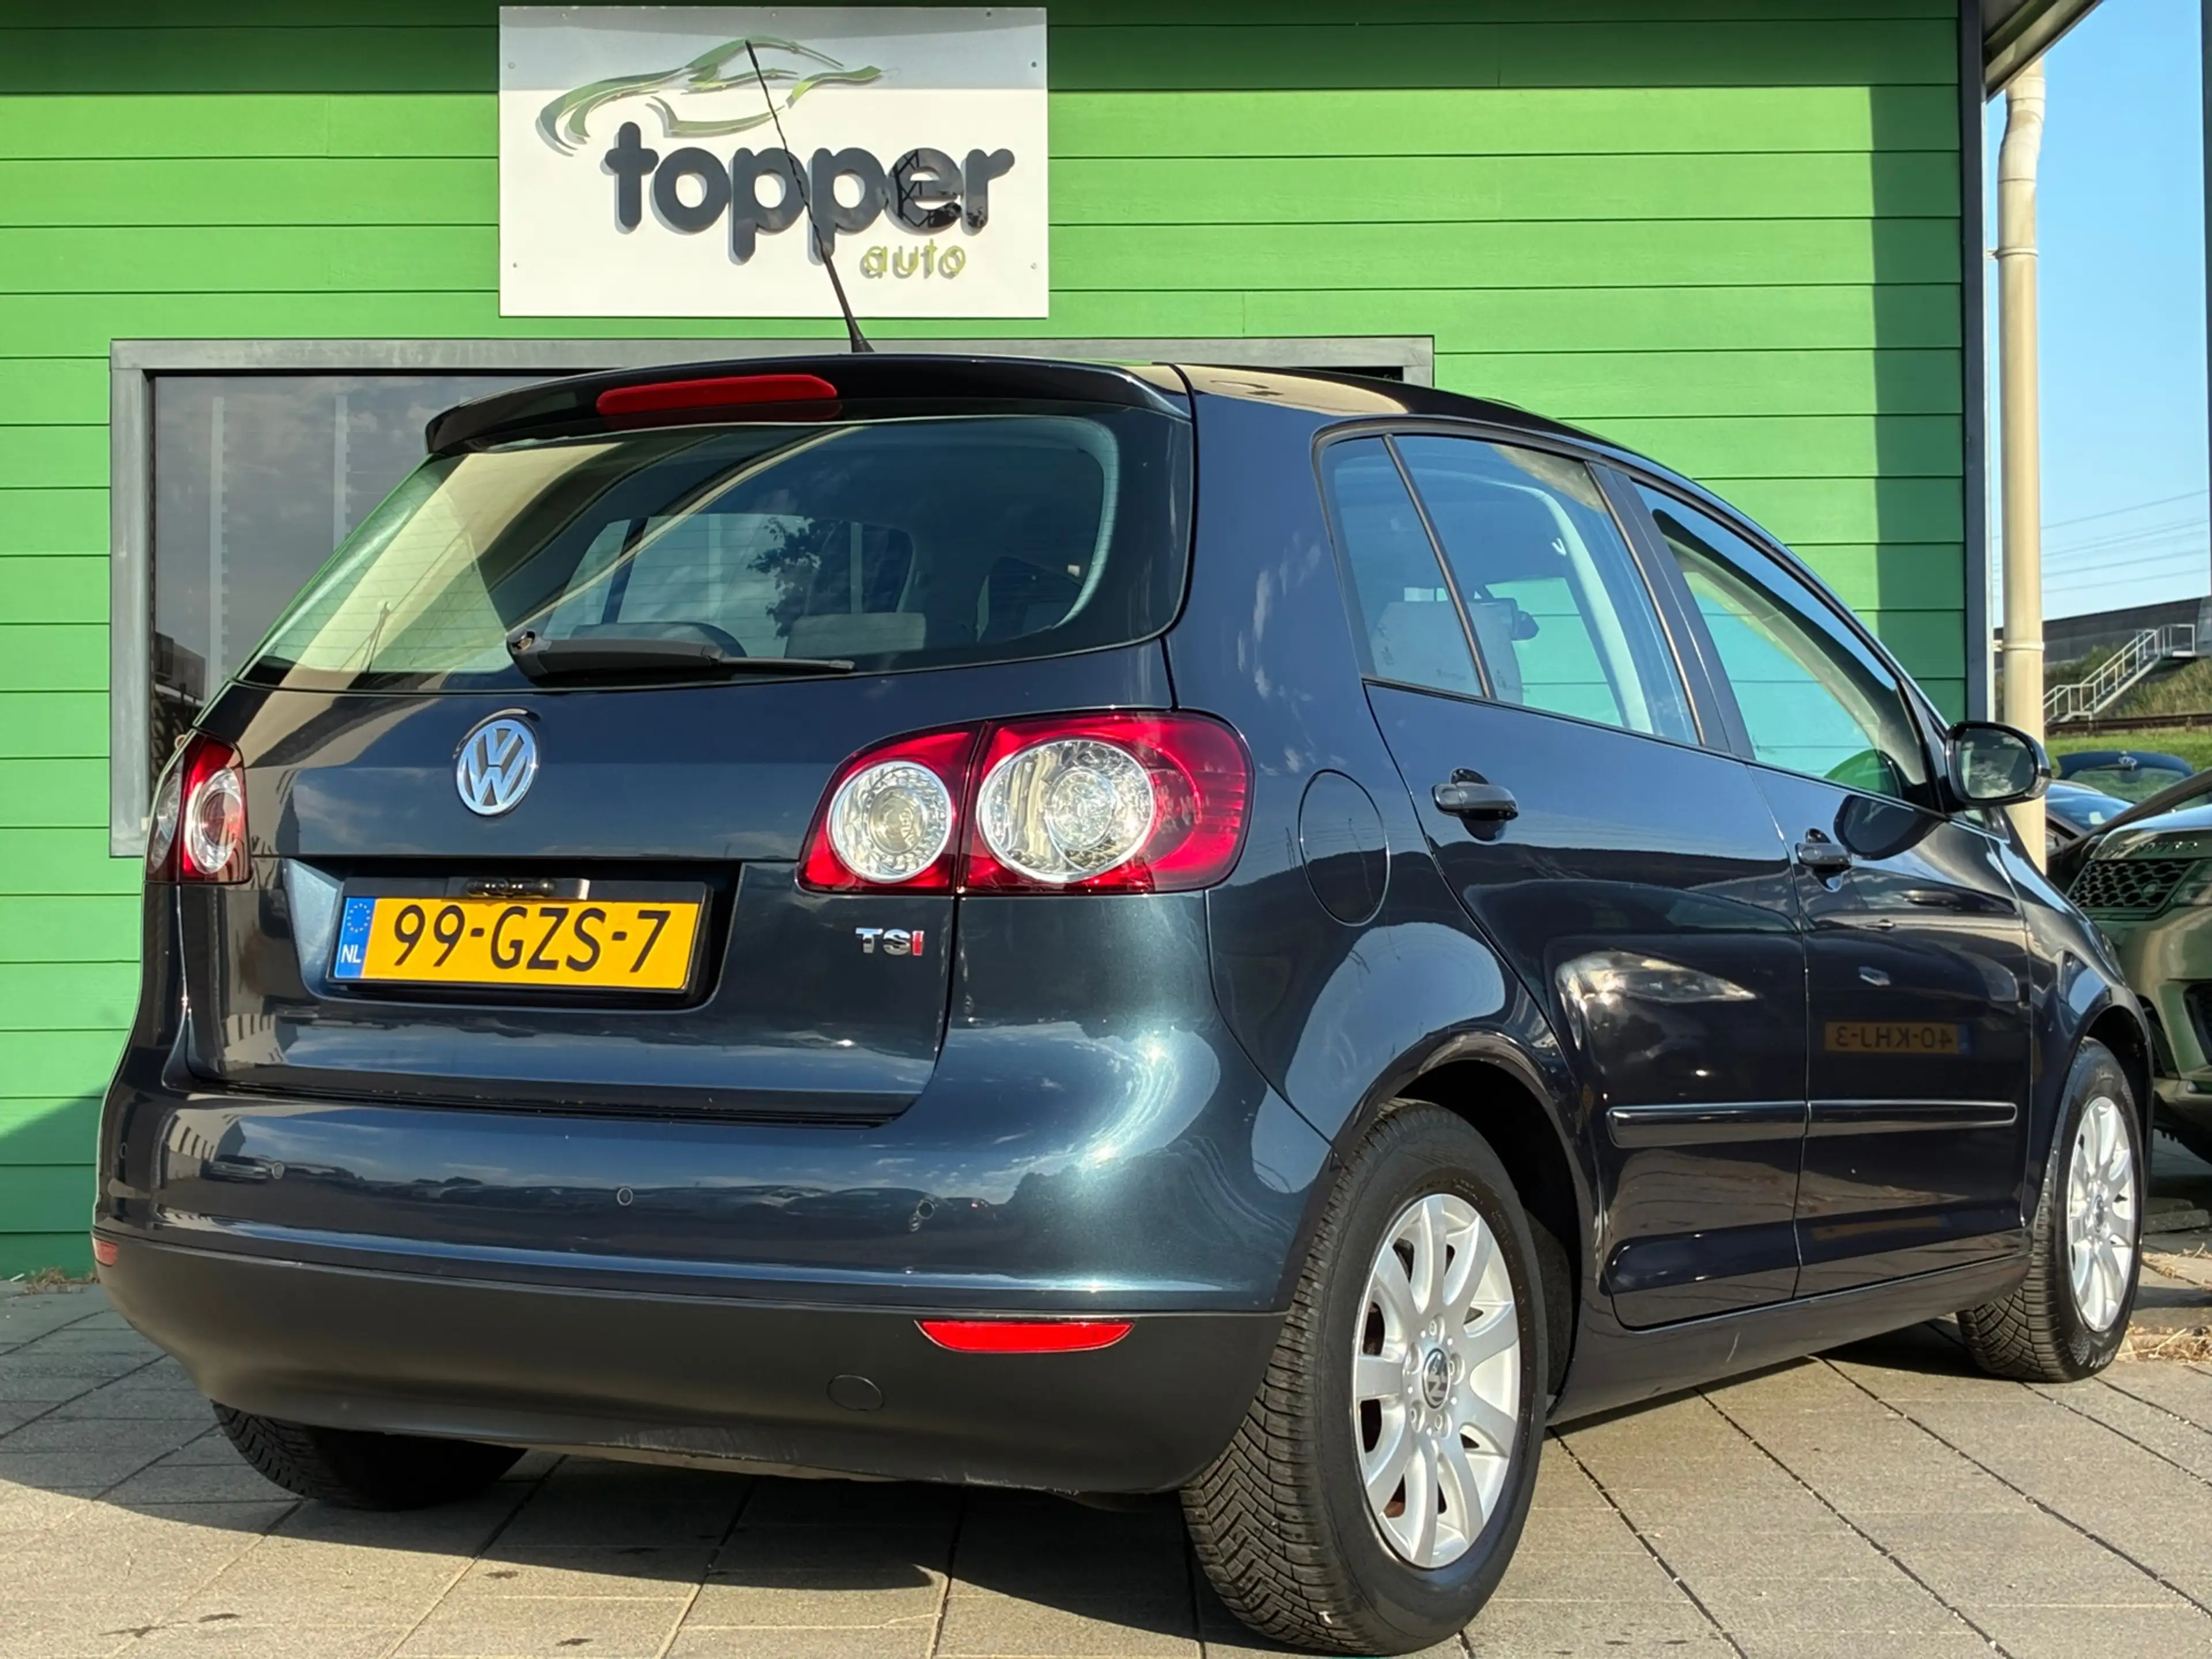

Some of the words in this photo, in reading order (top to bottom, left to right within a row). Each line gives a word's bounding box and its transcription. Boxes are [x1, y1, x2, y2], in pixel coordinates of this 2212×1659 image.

[604, 121, 1015, 260] topper
[863, 238, 966, 275] auto
[340, 944, 361, 963] NL
[393, 904, 671, 974] 99-GZS-7
[855, 927, 925, 956] TSI
